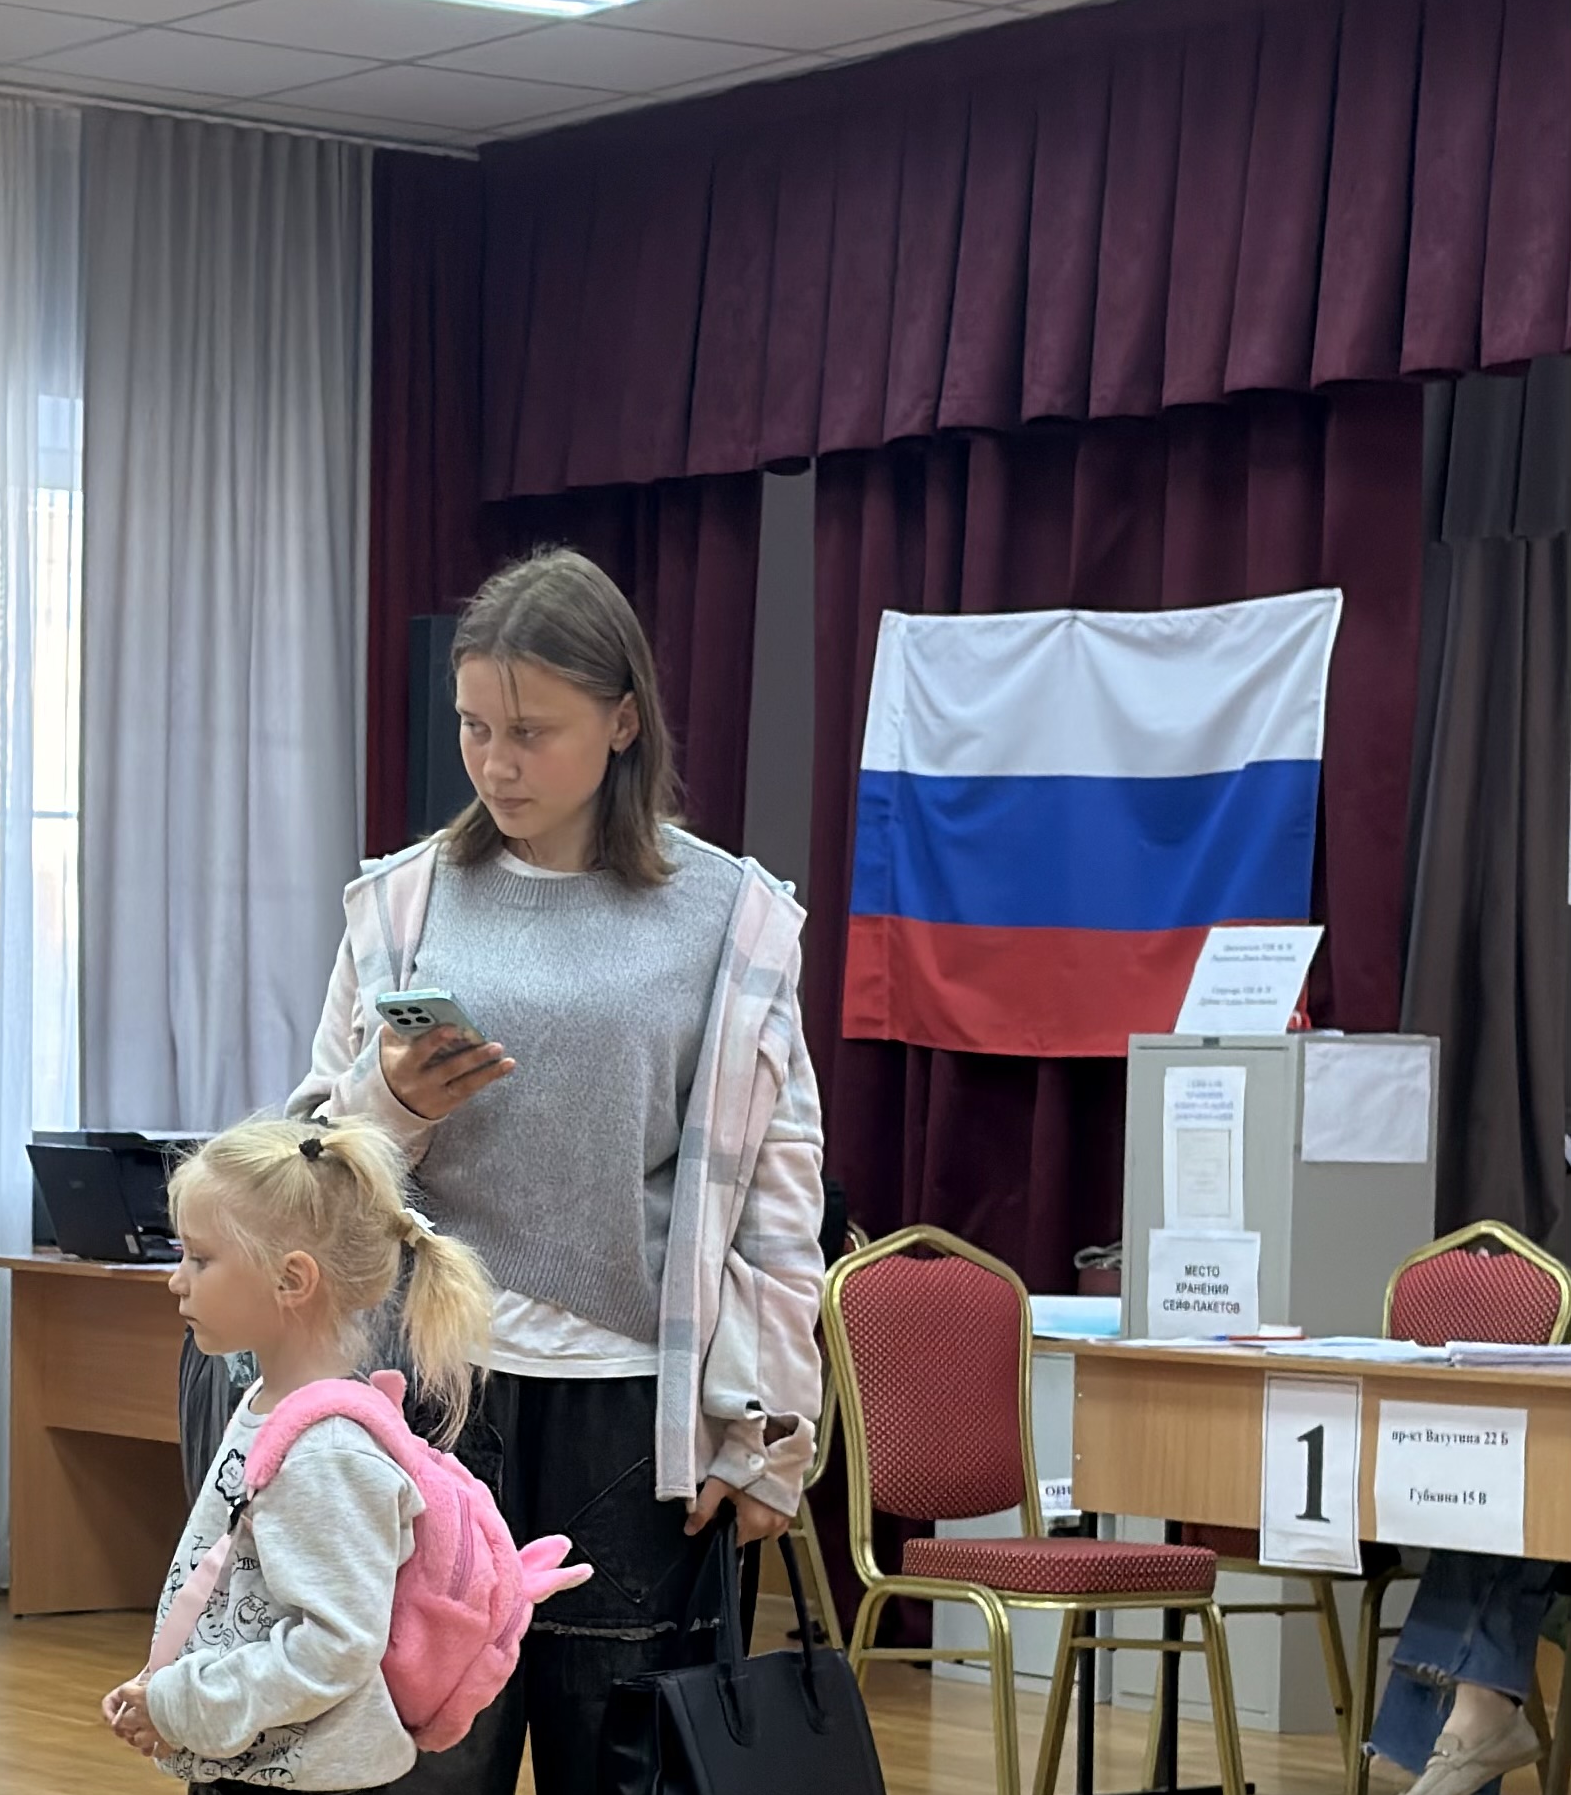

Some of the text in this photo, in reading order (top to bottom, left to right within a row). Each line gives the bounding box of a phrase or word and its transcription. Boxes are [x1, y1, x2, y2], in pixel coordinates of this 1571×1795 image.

[1184, 1265, 1220, 1278] МЕСТО
[1175, 1283, 1229, 1295] ХРАНЕНИЯ
[1426, 1429, 1480, 1446] Ватутина
[1484, 1432, 1497, 1445] 22
[1501, 1431, 1509, 1445] Б
[1295, 1424, 1331, 1523] 1
[1409, 1488, 1458, 1505] Губкина
[1462, 1491, 1475, 1505] 15
